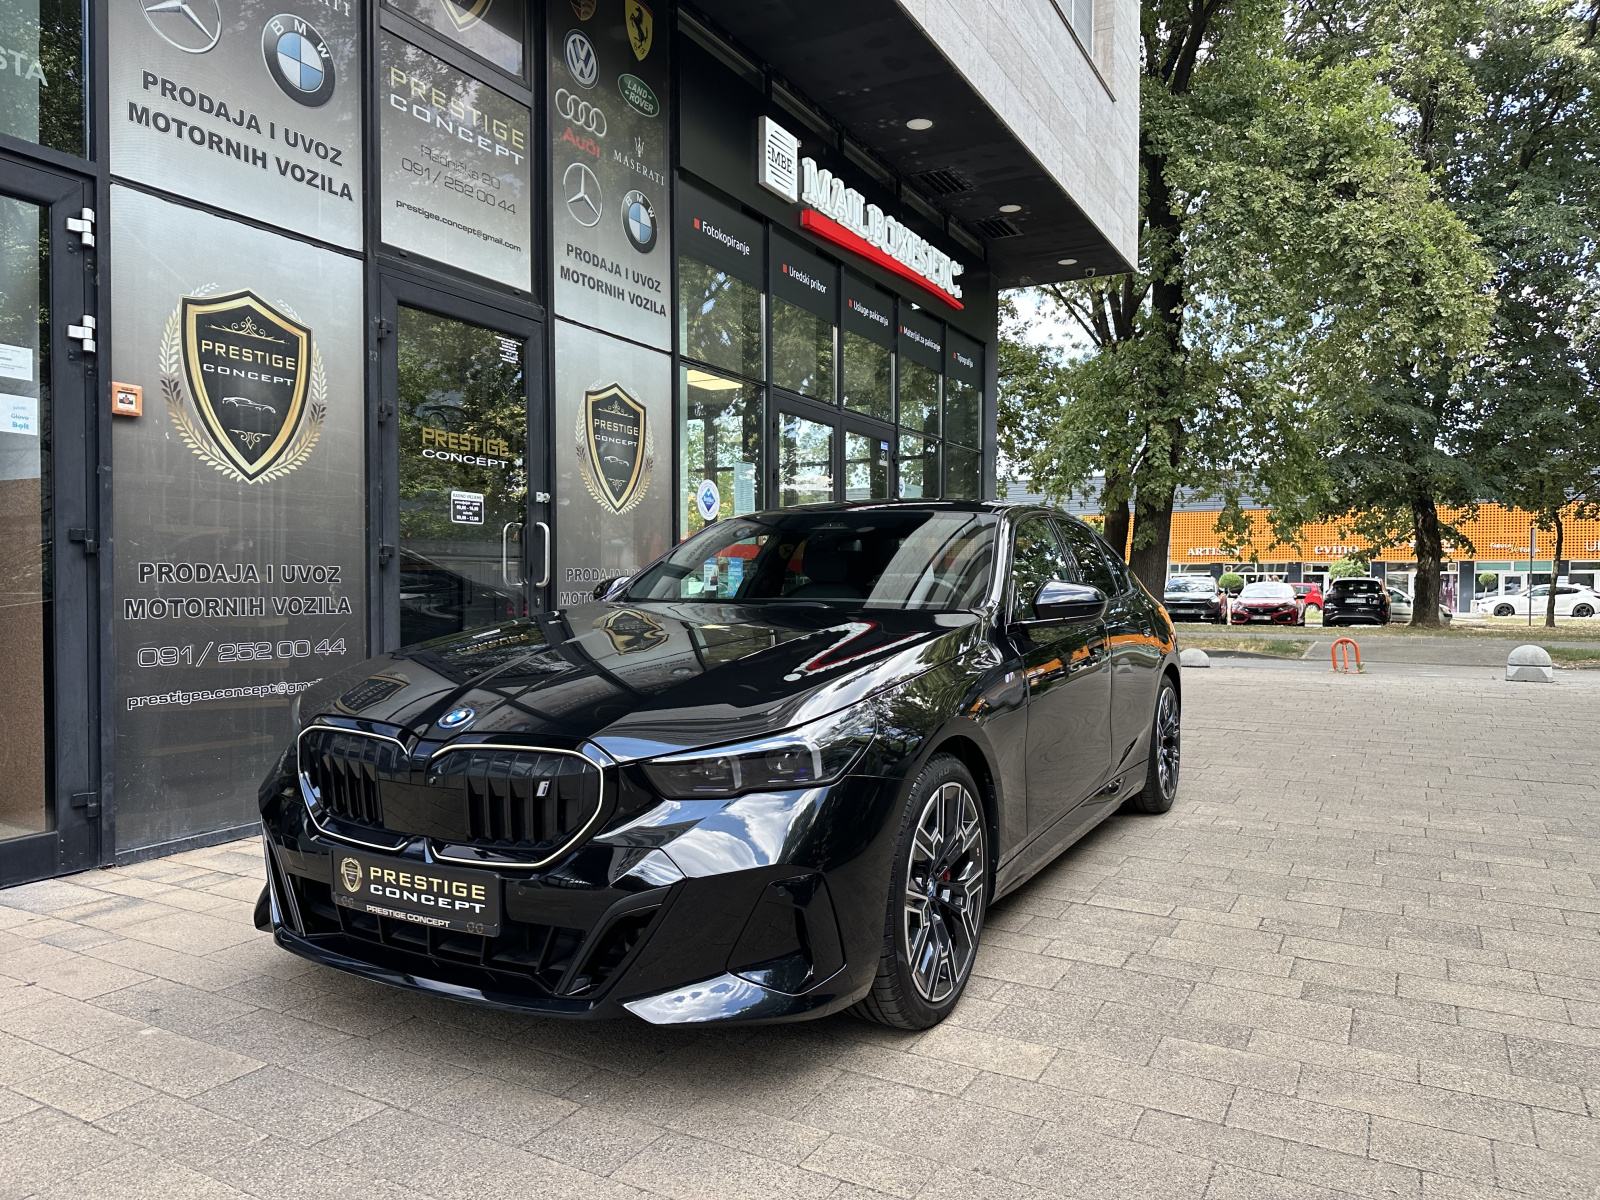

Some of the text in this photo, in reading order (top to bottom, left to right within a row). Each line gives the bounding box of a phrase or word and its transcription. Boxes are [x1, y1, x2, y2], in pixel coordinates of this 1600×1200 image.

[271, 19, 330, 59] BMW
[627, 80, 648, 98] LAND
[629, 91, 654, 114] ROVER
[141, 69, 344, 167] PRODAJA I UVOZ
[390, 66, 524, 150] PRESTIGE
[390, 93, 524, 165] CONCEPT
[560, 127, 600, 158] Audi
[128, 101, 353, 202] MOTORNIH VOZILA
[771, 147, 793, 174] MBE
[481, 172, 501, 190] 20
[613, 149, 665, 186] MASERATI
[401, 157, 430, 181] 091
[444, 175, 474, 198] 252
[476, 188, 496, 207] 00
[498, 200, 516, 215] 44
[625, 193, 655, 218] BMW
[802, 157, 871, 241] MAIL
[866, 203, 930, 278] BOXES
[396, 199, 522, 252] prestigee.concept@gmail.com
[702, 220, 750, 256] Fotokopiranje
[566, 243, 662, 293] PRODAJA I UVOZ
[789, 265, 827, 294] Uredski pribor
[560, 265, 667, 317] MOTORNIH VOZILA
[201, 339, 296, 371] PRESTIGE
[203, 363, 294, 386] CONCEPT
[422, 426, 509, 457] PRESTIGE
[594, 418, 639, 436] PRESTIGE
[594, 434, 638, 447] CONCEPT
[422, 449, 509, 469] CONCEPT
[138, 562, 341, 584] PRODAJA I UVOZ
[124, 596, 352, 619] MOTORNIH VOZILA
[138, 646, 192, 668] 091
[217, 641, 272, 663] 252
[276, 639, 311, 659] 00
[314, 638, 347, 656] 44
[127, 677, 324, 711] prestigee.concept@gm
[369, 866, 486, 901] PRESTIGE
[369, 883, 486, 914] CONCEPT
[366, 904, 450, 928] PRESTIGE CONCEPT
